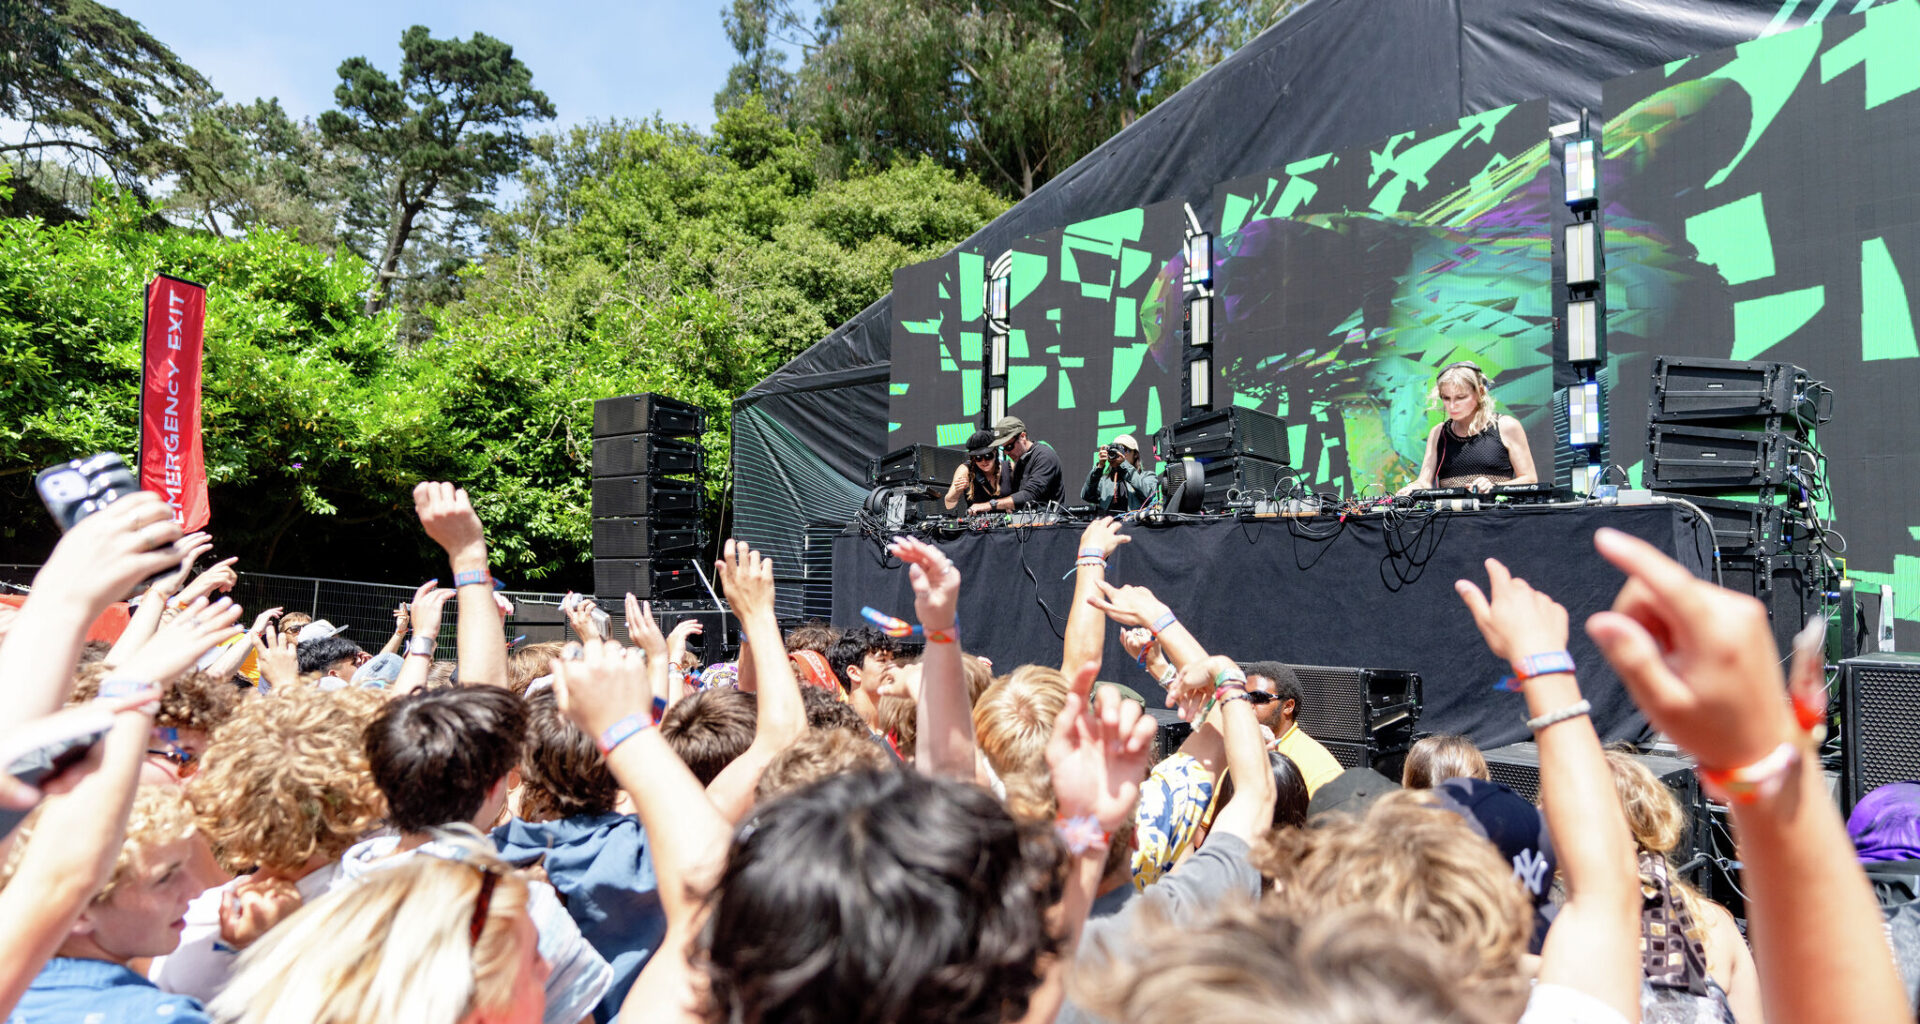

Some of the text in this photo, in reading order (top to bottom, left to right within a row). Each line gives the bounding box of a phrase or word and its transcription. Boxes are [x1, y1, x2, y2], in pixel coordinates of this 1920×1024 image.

[163, 289, 185, 524] EMERGENCY EXIT
[1512, 847, 1548, 895] NY
